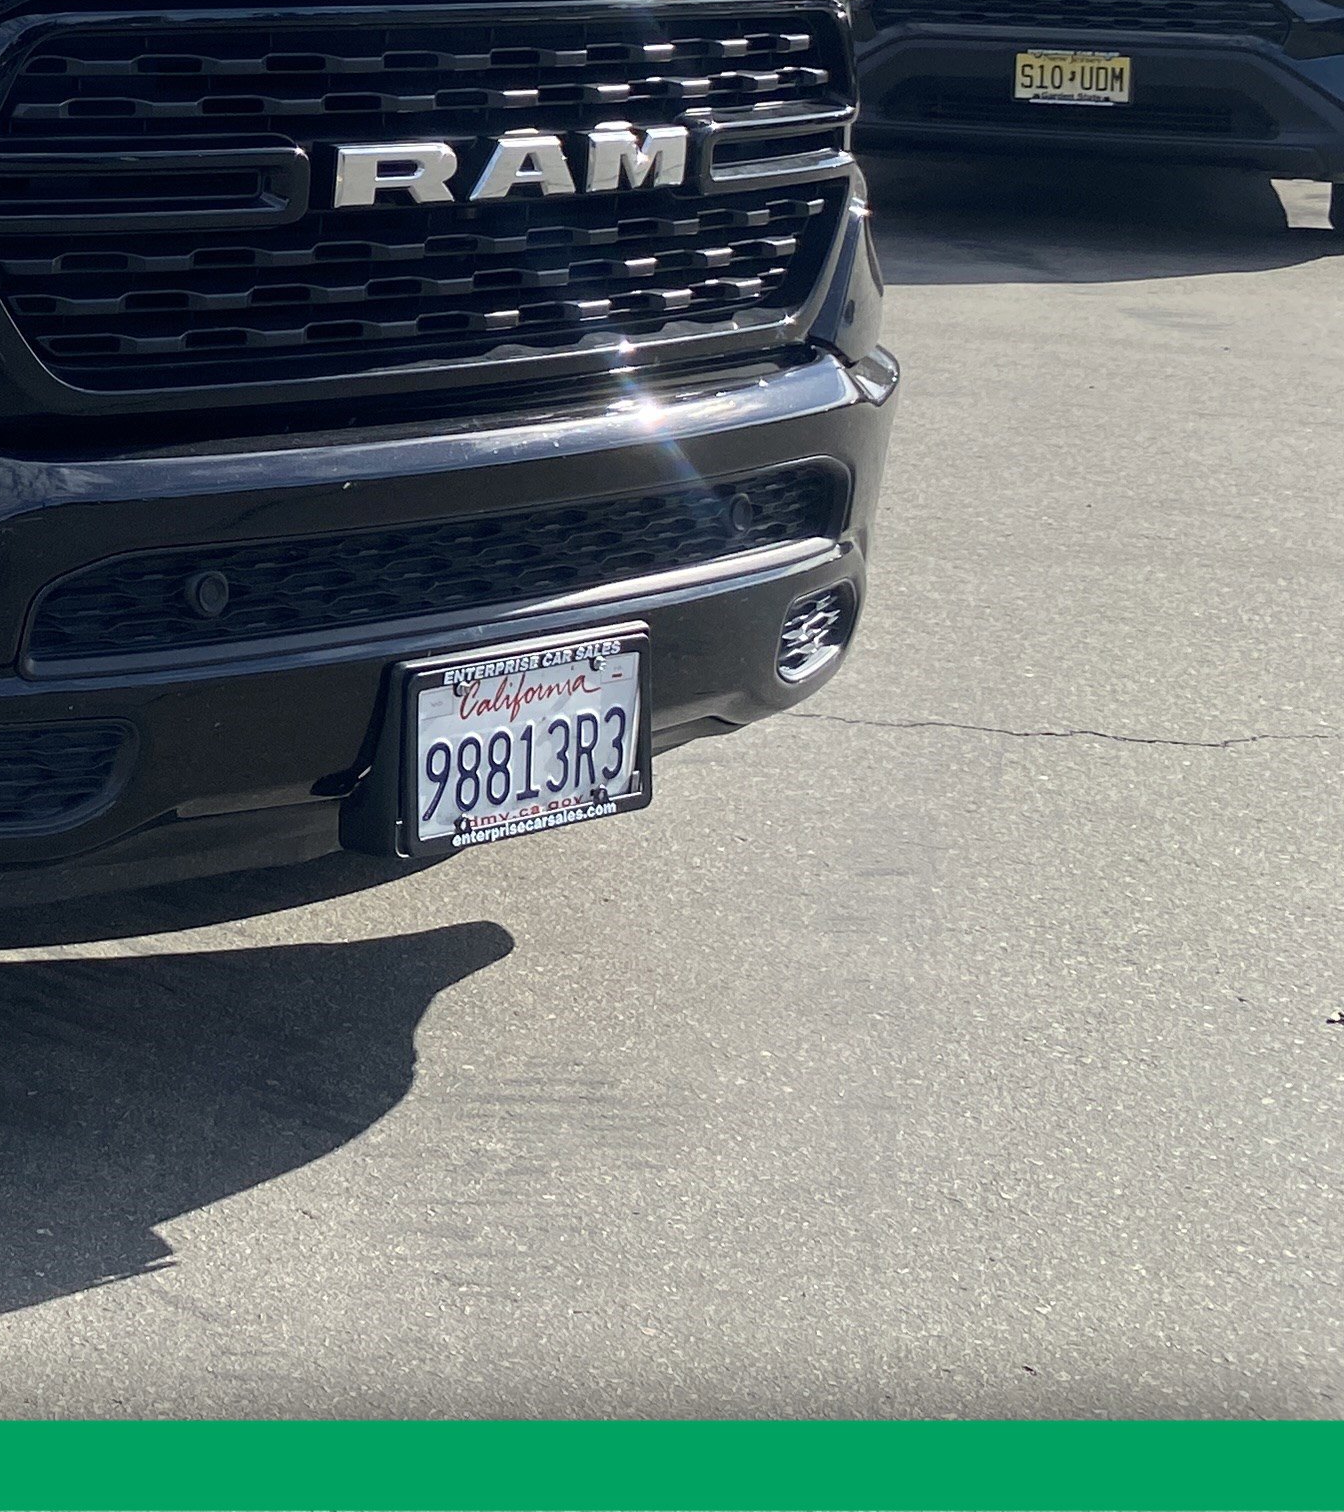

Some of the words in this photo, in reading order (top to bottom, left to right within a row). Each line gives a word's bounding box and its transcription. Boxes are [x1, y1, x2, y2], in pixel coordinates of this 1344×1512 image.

[1020, 64, 1064, 90] S10
[1080, 65, 1125, 93] UDM
[332, 125, 690, 209] RAM
[443, 655, 538, 685] ENTERPRISE
[543, 649, 576, 668] CAR
[575, 640, 622, 661] SALES
[459, 673, 602, 724] California
[421, 705, 628, 822] 98813R3
[451, 801, 618, 847] enterprisecarsales.com
